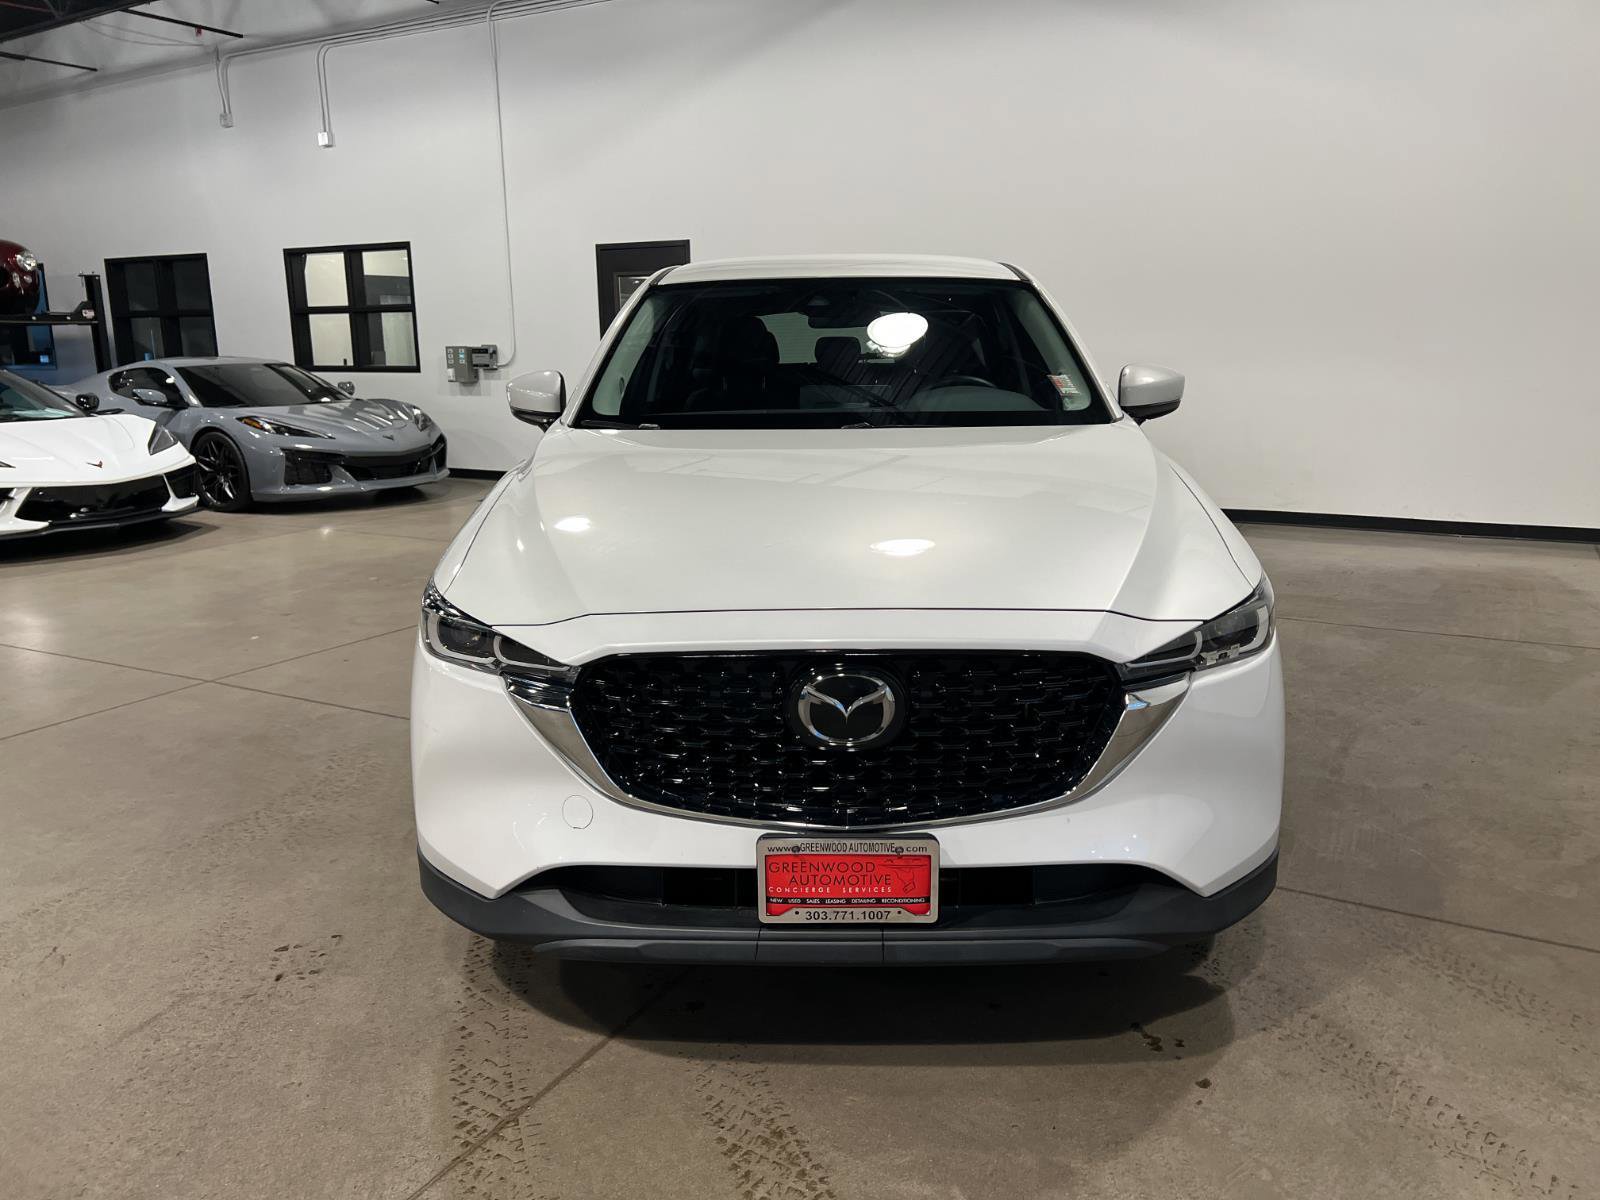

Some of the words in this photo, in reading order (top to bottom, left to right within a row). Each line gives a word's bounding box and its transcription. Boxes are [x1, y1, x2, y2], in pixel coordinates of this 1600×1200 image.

[769, 861, 875, 873] GREENWOOD
[789, 874, 891, 885] AUTOMOTIVE
[805, 910, 891, 920] 303.771.1007
